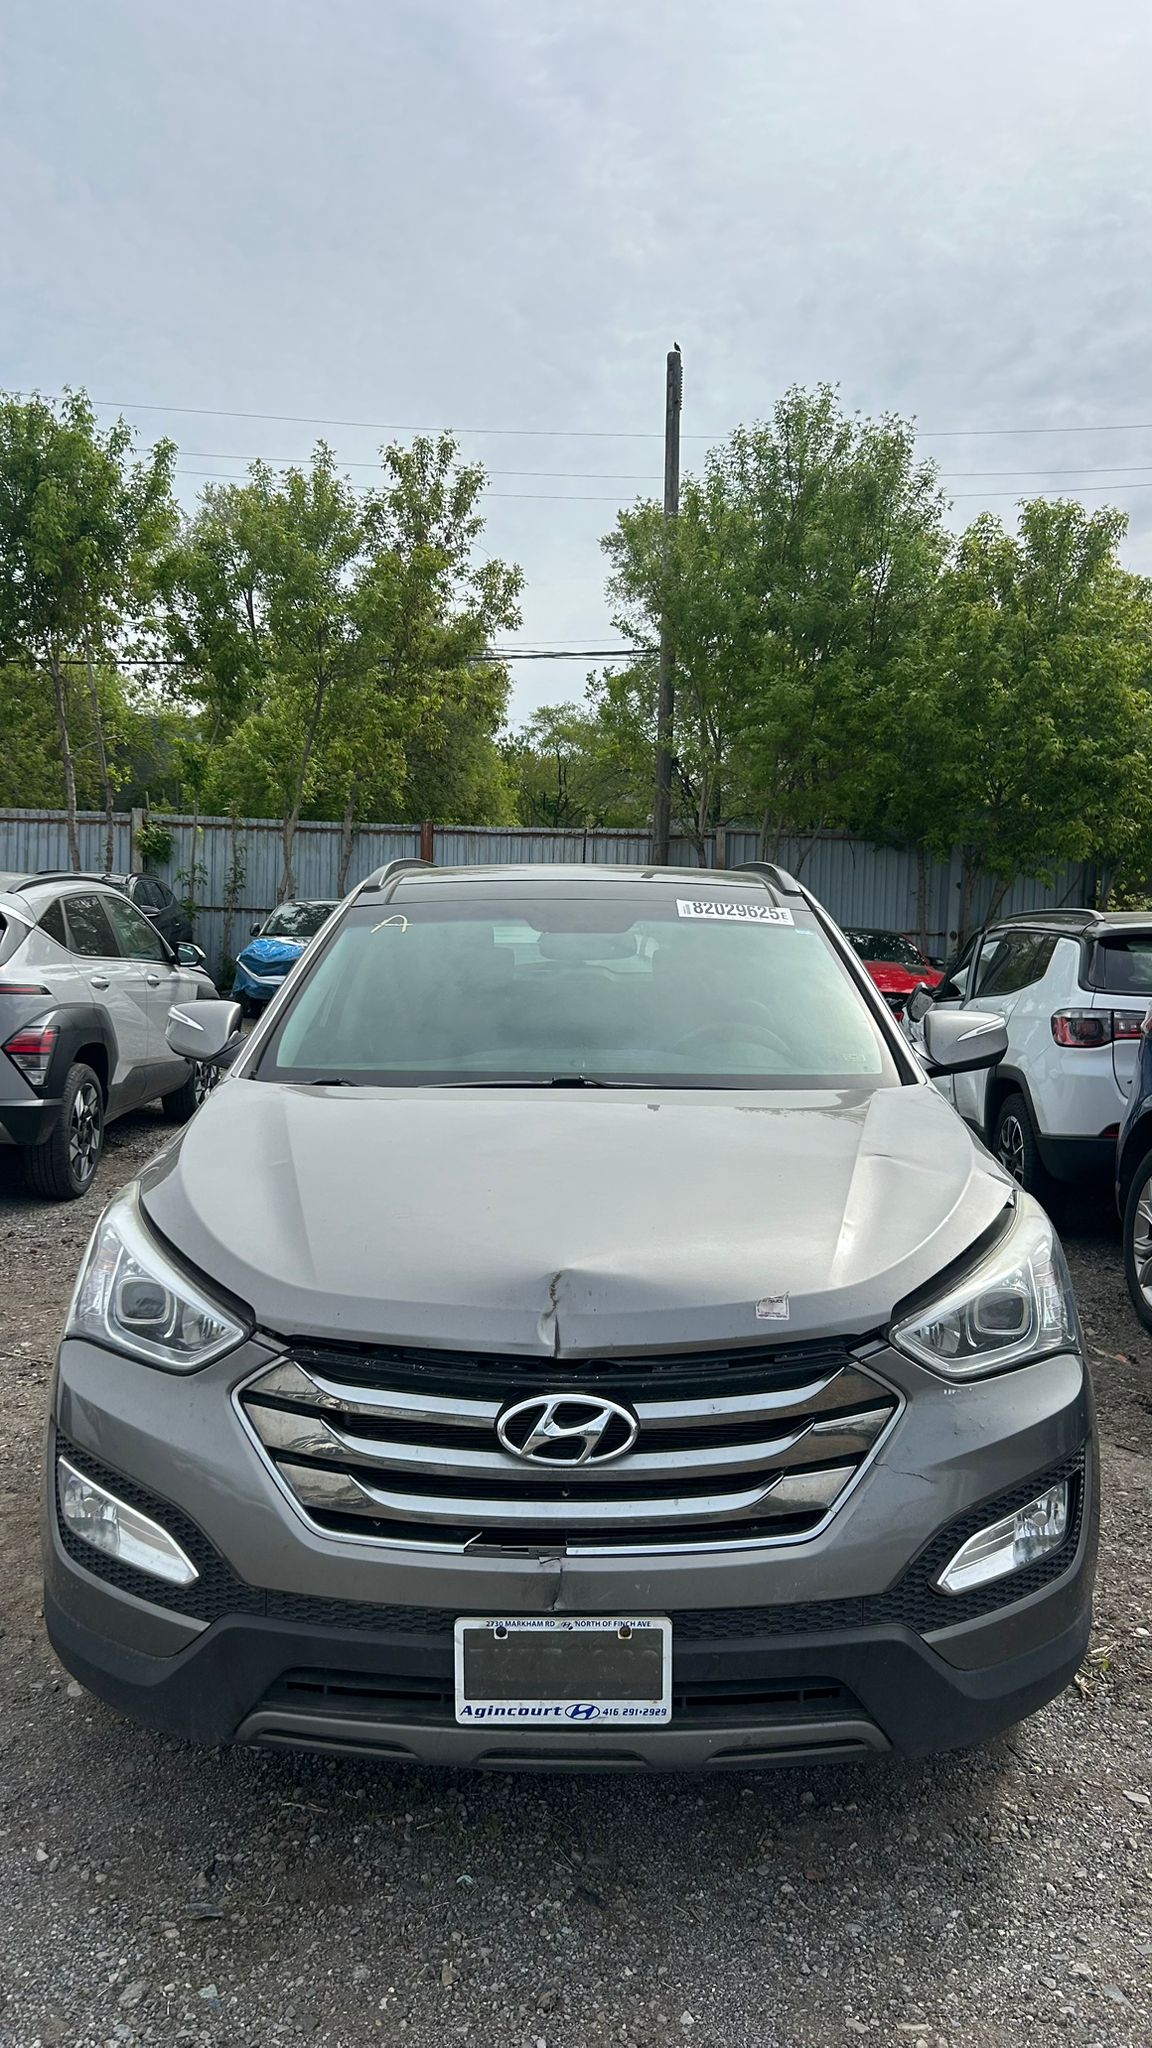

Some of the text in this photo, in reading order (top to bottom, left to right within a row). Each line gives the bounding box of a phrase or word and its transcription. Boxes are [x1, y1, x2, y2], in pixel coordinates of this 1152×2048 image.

[614, 1620, 636, 1628] FINCH
[460, 1705, 563, 1718] Agincourt
[602, 1708, 619, 1716] 416
